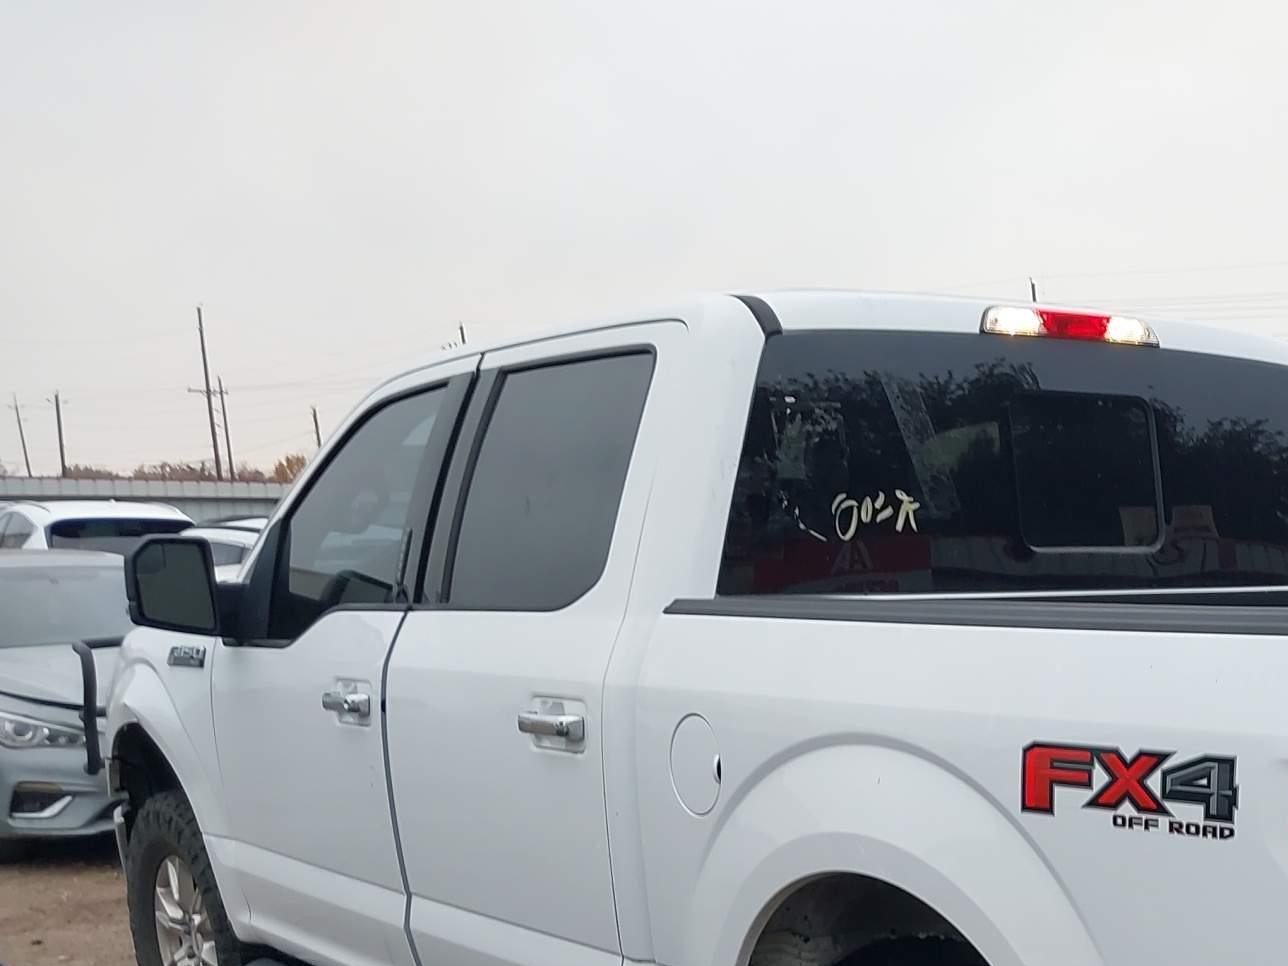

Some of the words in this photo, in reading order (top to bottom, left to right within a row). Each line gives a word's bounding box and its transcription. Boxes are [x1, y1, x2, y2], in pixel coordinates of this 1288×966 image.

[1021, 741, 1238, 824] FX4
[1112, 814, 1159, 831] OFF
[1169, 820, 1235, 840] ROAD
